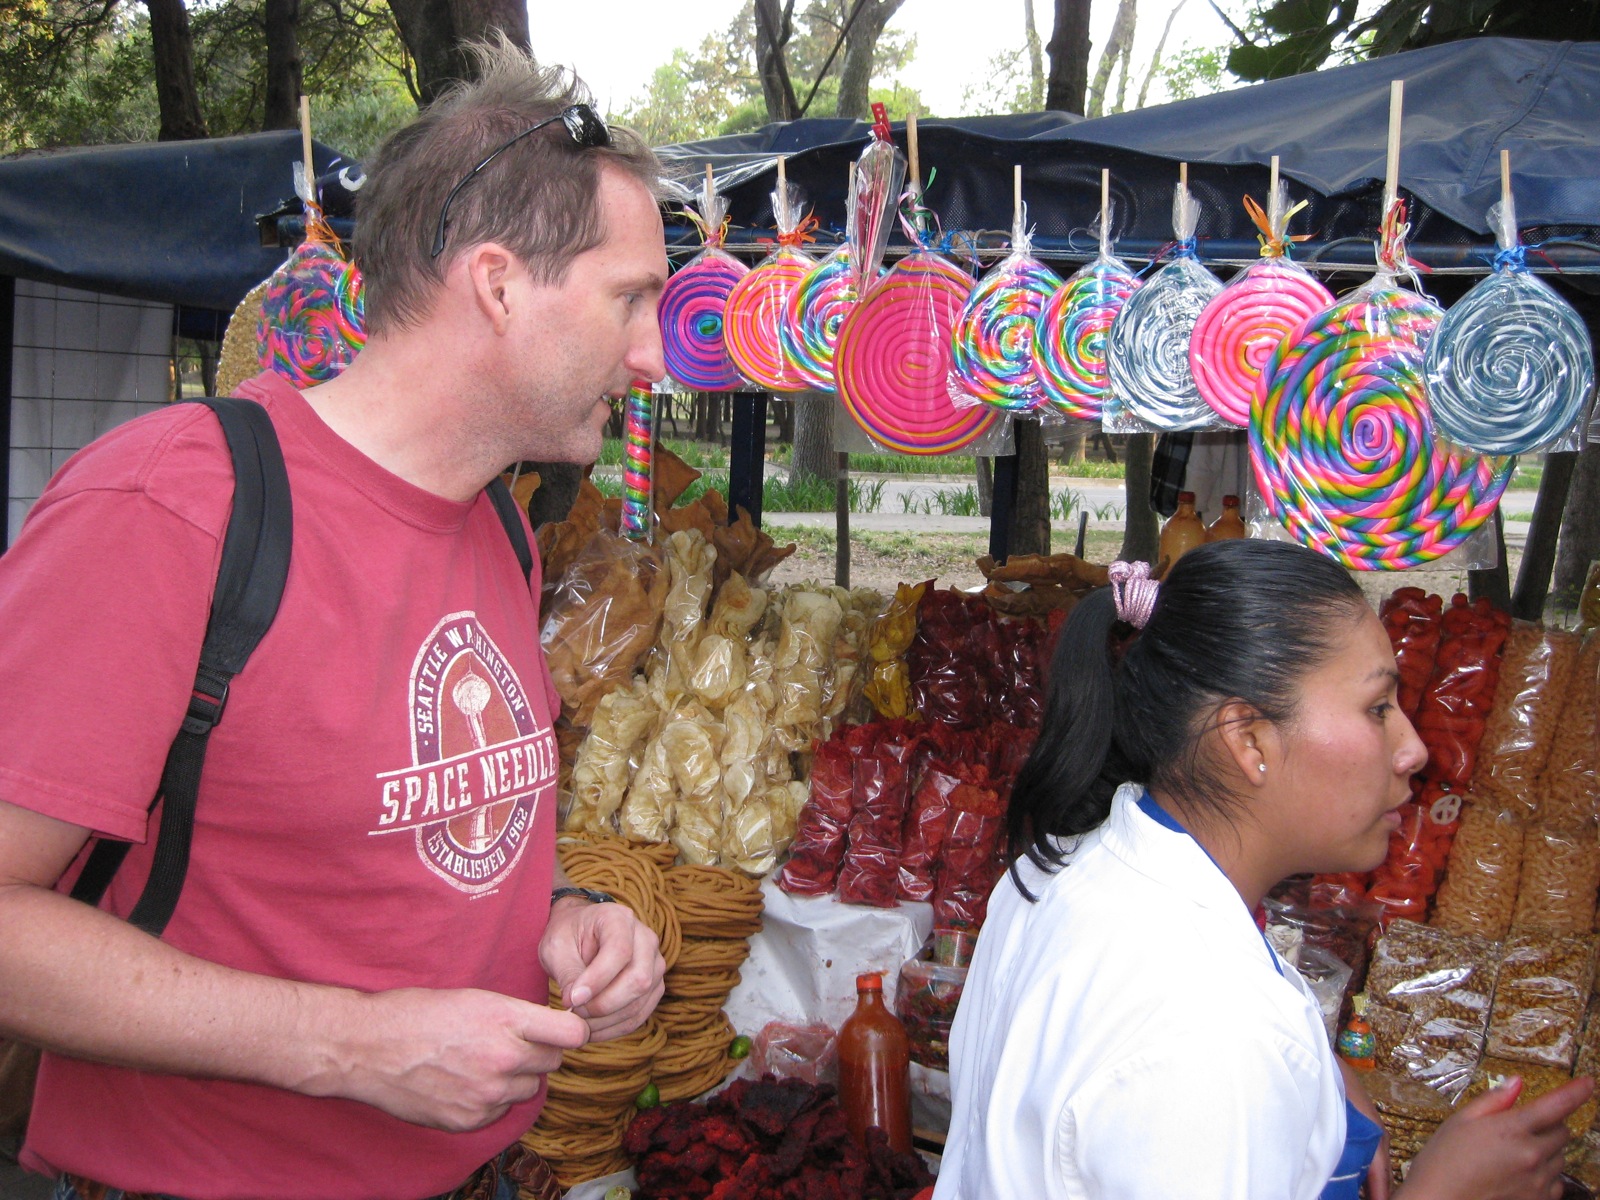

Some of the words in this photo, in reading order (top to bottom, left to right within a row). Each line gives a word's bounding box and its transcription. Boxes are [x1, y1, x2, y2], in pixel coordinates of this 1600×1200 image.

[417, 641, 449, 735] SEATTLE
[444, 623, 525, 712] WAHINGTON
[378, 761, 472, 826] SPACE
[479, 735, 557, 800] NEEDLE
[427, 830, 507, 879] ESTABLISHED
[505, 806, 529, 850] 1962
